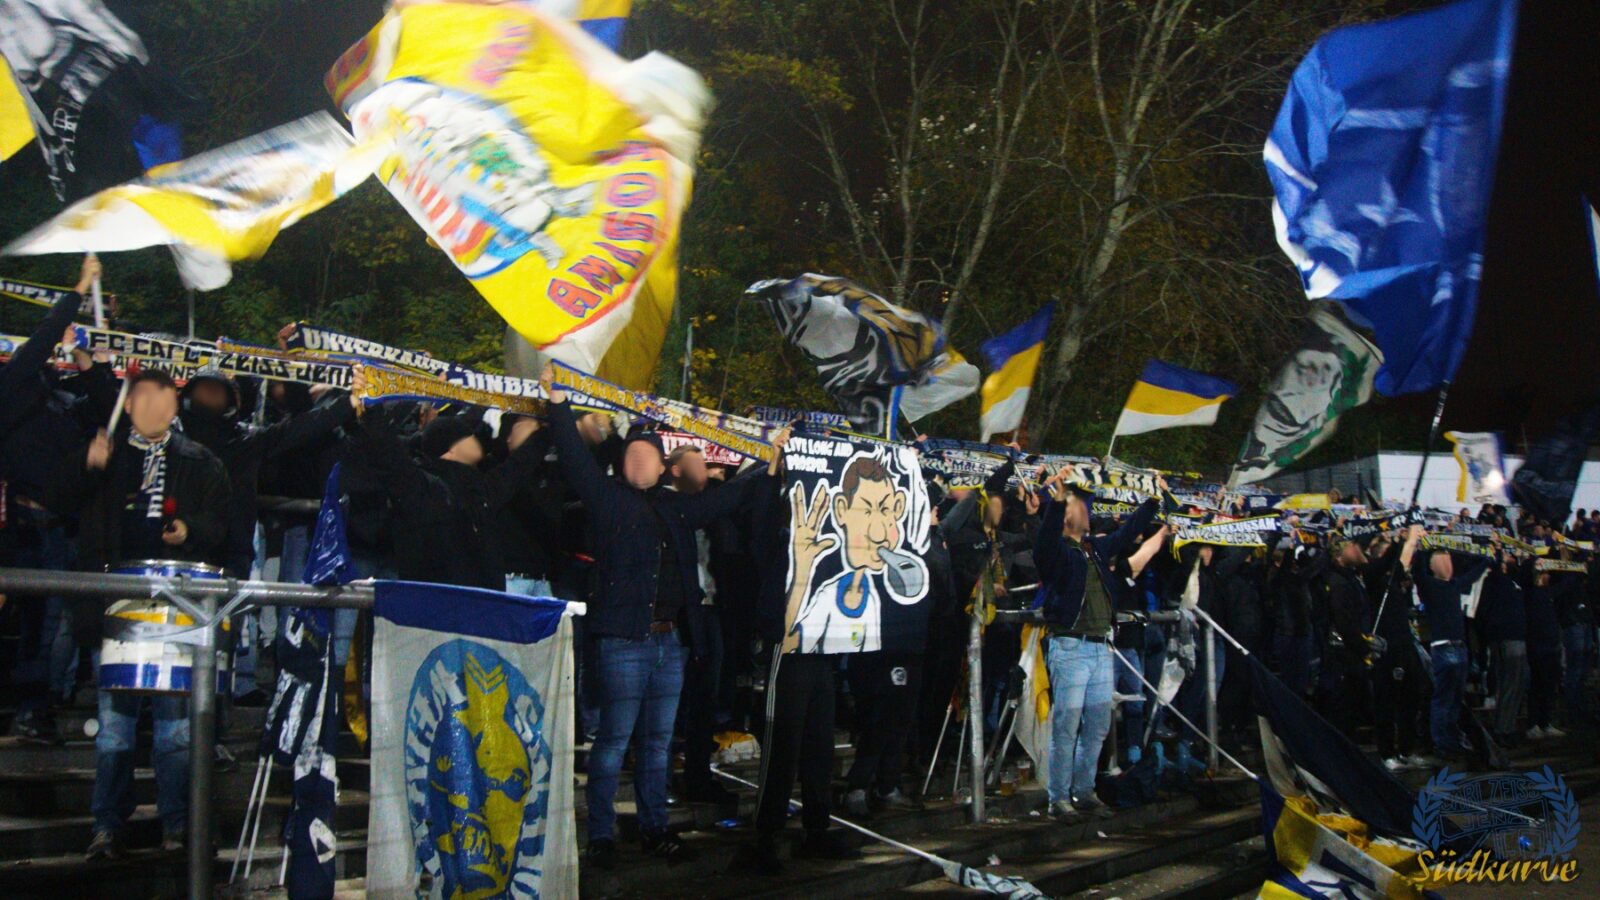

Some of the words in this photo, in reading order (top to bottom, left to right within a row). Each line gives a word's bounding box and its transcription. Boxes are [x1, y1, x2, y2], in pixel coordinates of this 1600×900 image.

[89, 331, 125, 351] FC
[808, 439, 834, 456] LONG
[833, 442, 854, 457] AND
